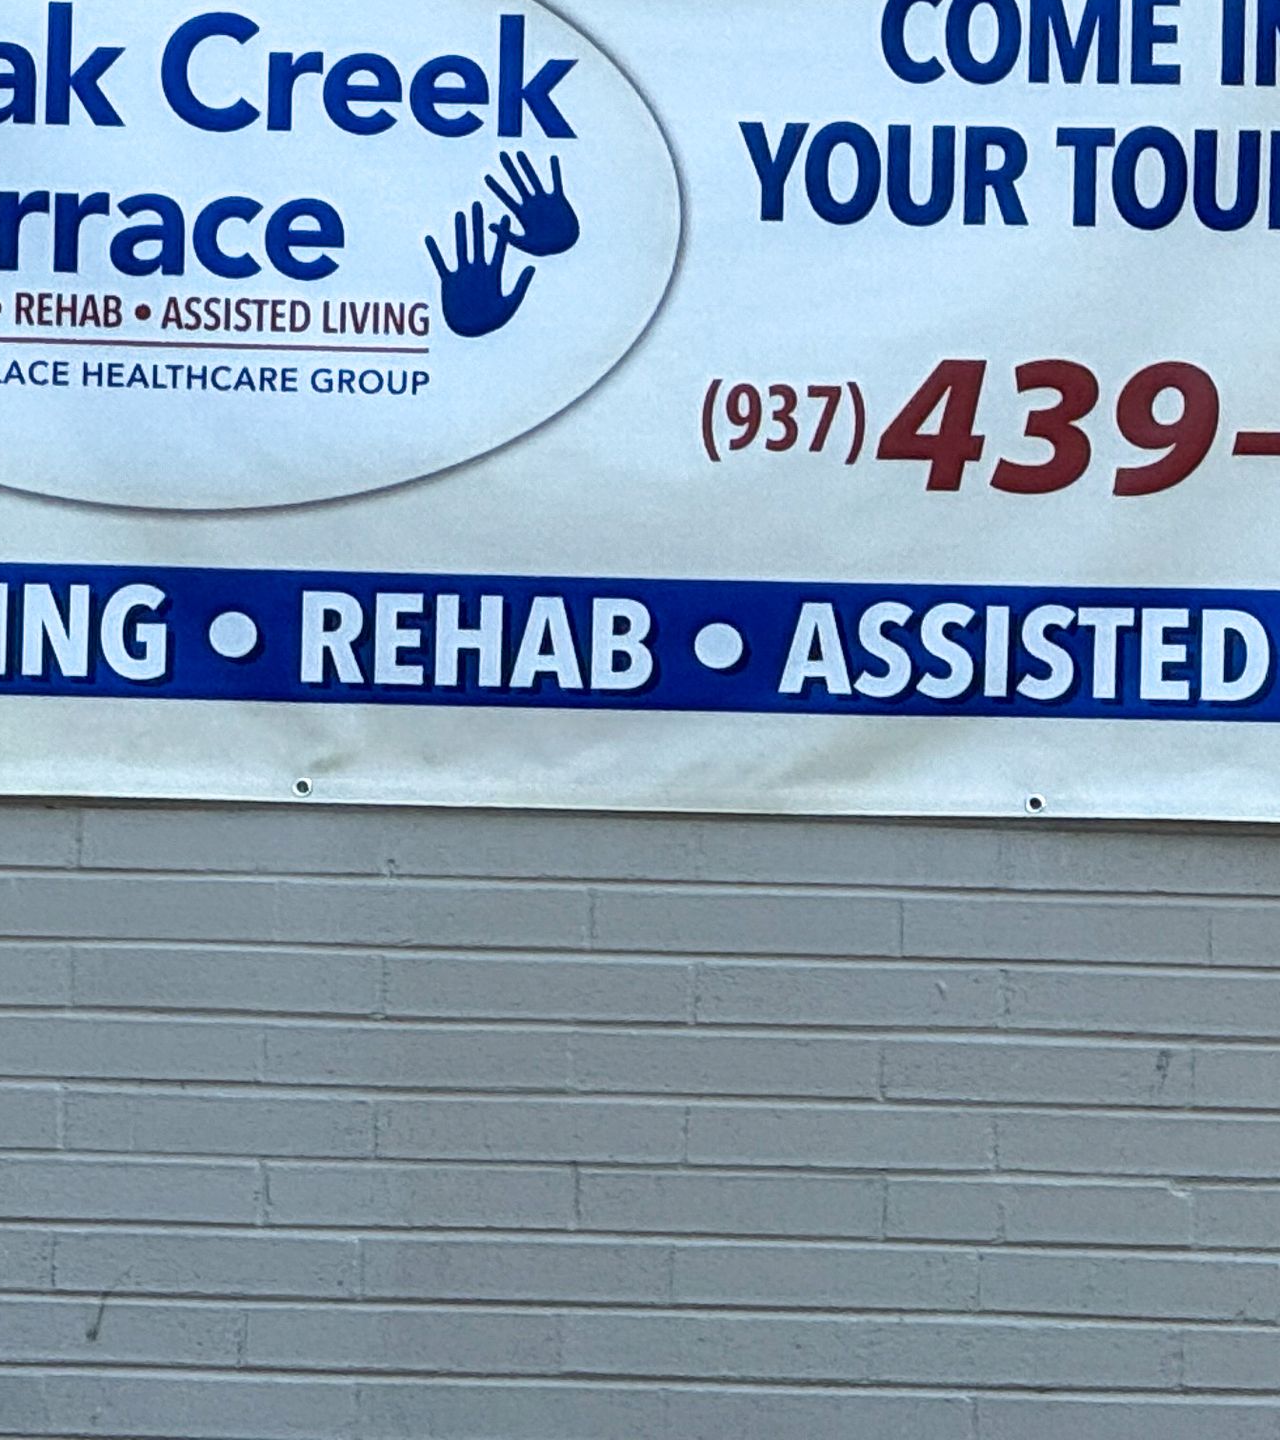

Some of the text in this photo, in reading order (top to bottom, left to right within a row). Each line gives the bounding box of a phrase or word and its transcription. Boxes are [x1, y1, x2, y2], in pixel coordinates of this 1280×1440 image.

[161, 13, 578, 138] Creek
[739, 122, 1028, 226] YOUR
[16, 293, 122, 328] REHAB
[161, 297, 310, 332] ASSISTED
[323, 301, 429, 336] LIVING
[83, 362, 297, 392] HEALTHCARE
[311, 369, 429, 395] GROUP
[703, 379, 865, 465] (937)
[301, 591, 652, 689] REHAB
[778, 602, 1269, 703] ASSISTED
